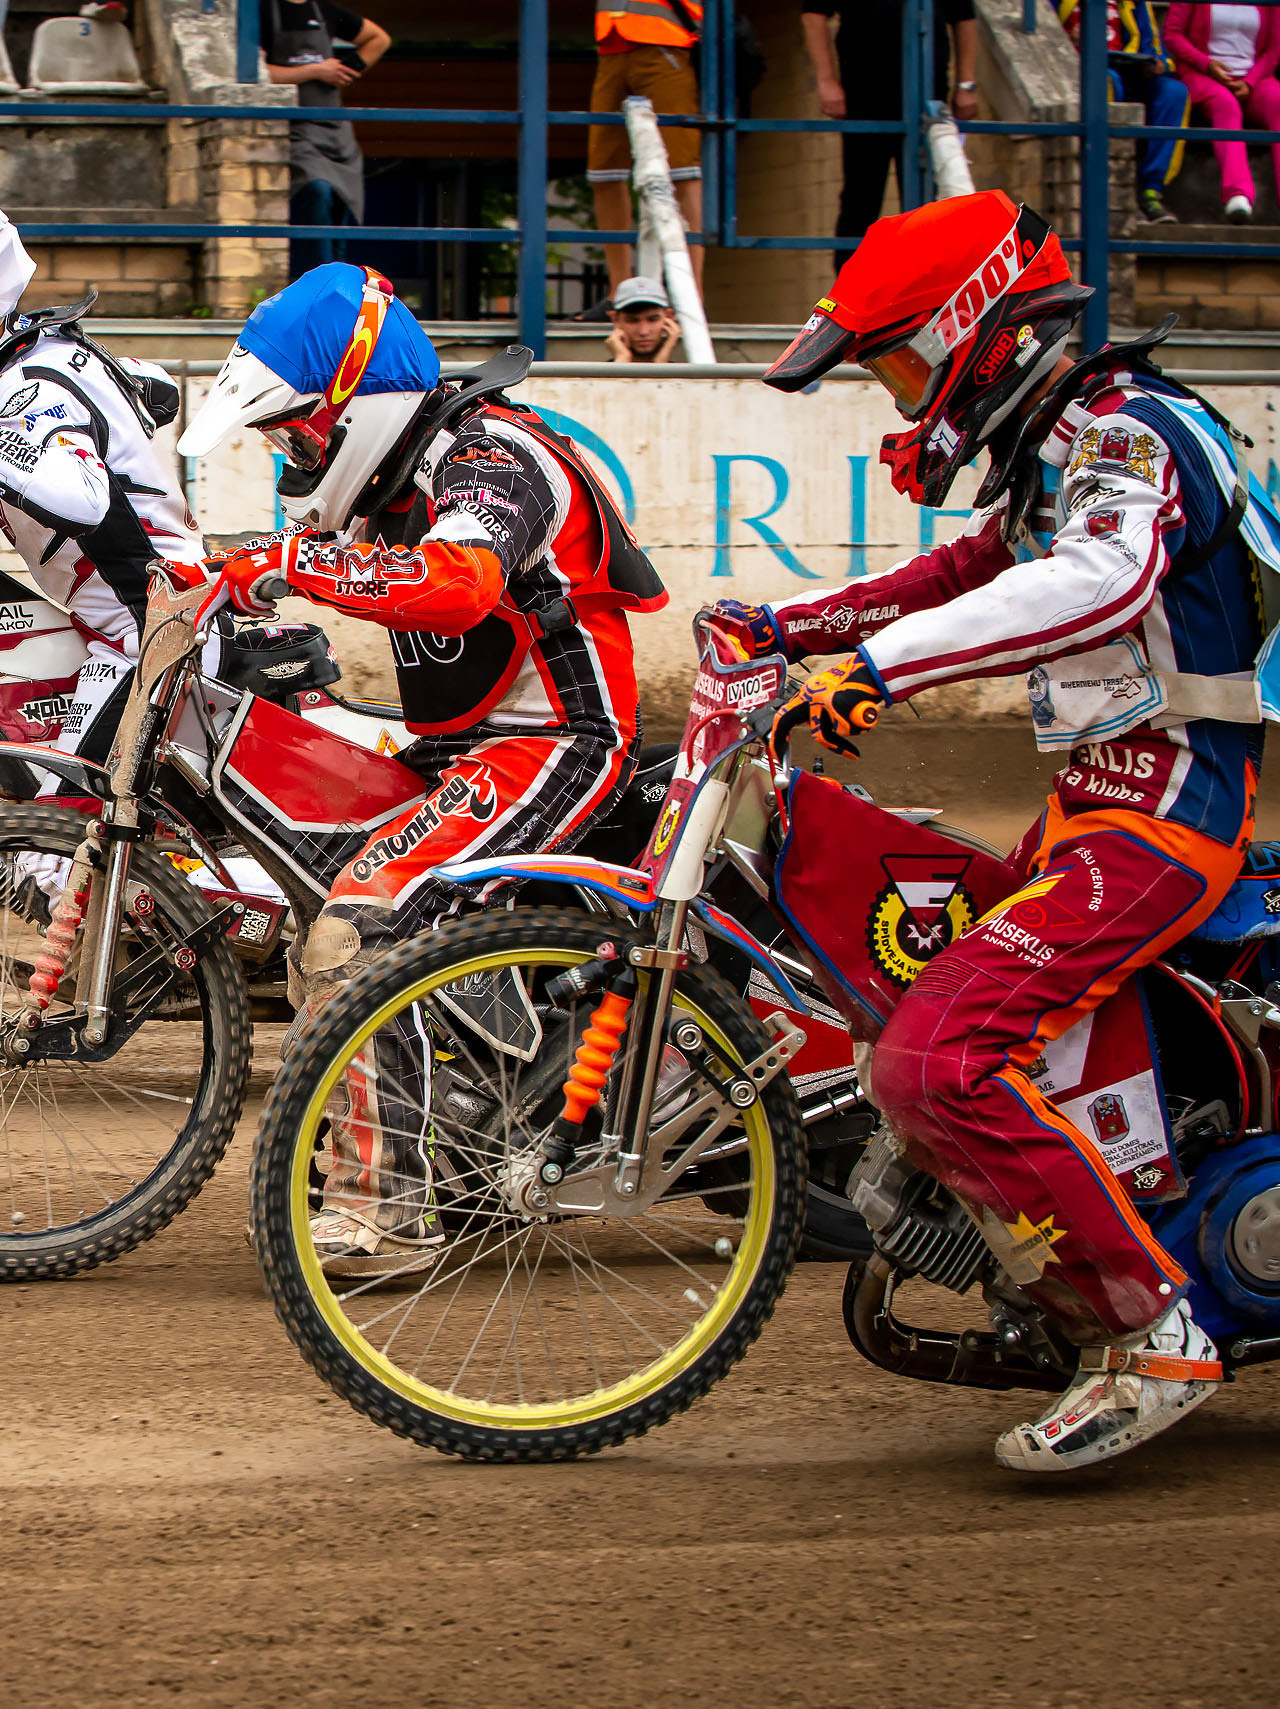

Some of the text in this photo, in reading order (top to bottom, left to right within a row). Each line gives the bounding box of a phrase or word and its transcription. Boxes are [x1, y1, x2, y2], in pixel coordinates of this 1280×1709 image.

[978, 332, 1015, 379] SHOEI
[335, 579, 389, 600] STORE
[784, 604, 903, 634] RACE WEAR
[1084, 773, 1145, 803] klubs
[1088, 866, 1104, 913] CENTRS
[981, 933, 1044, 968] ANNO 1989
[985, 917, 1055, 961] AUSEKLIS
[1118, 1138, 1140, 1153] DOMES
